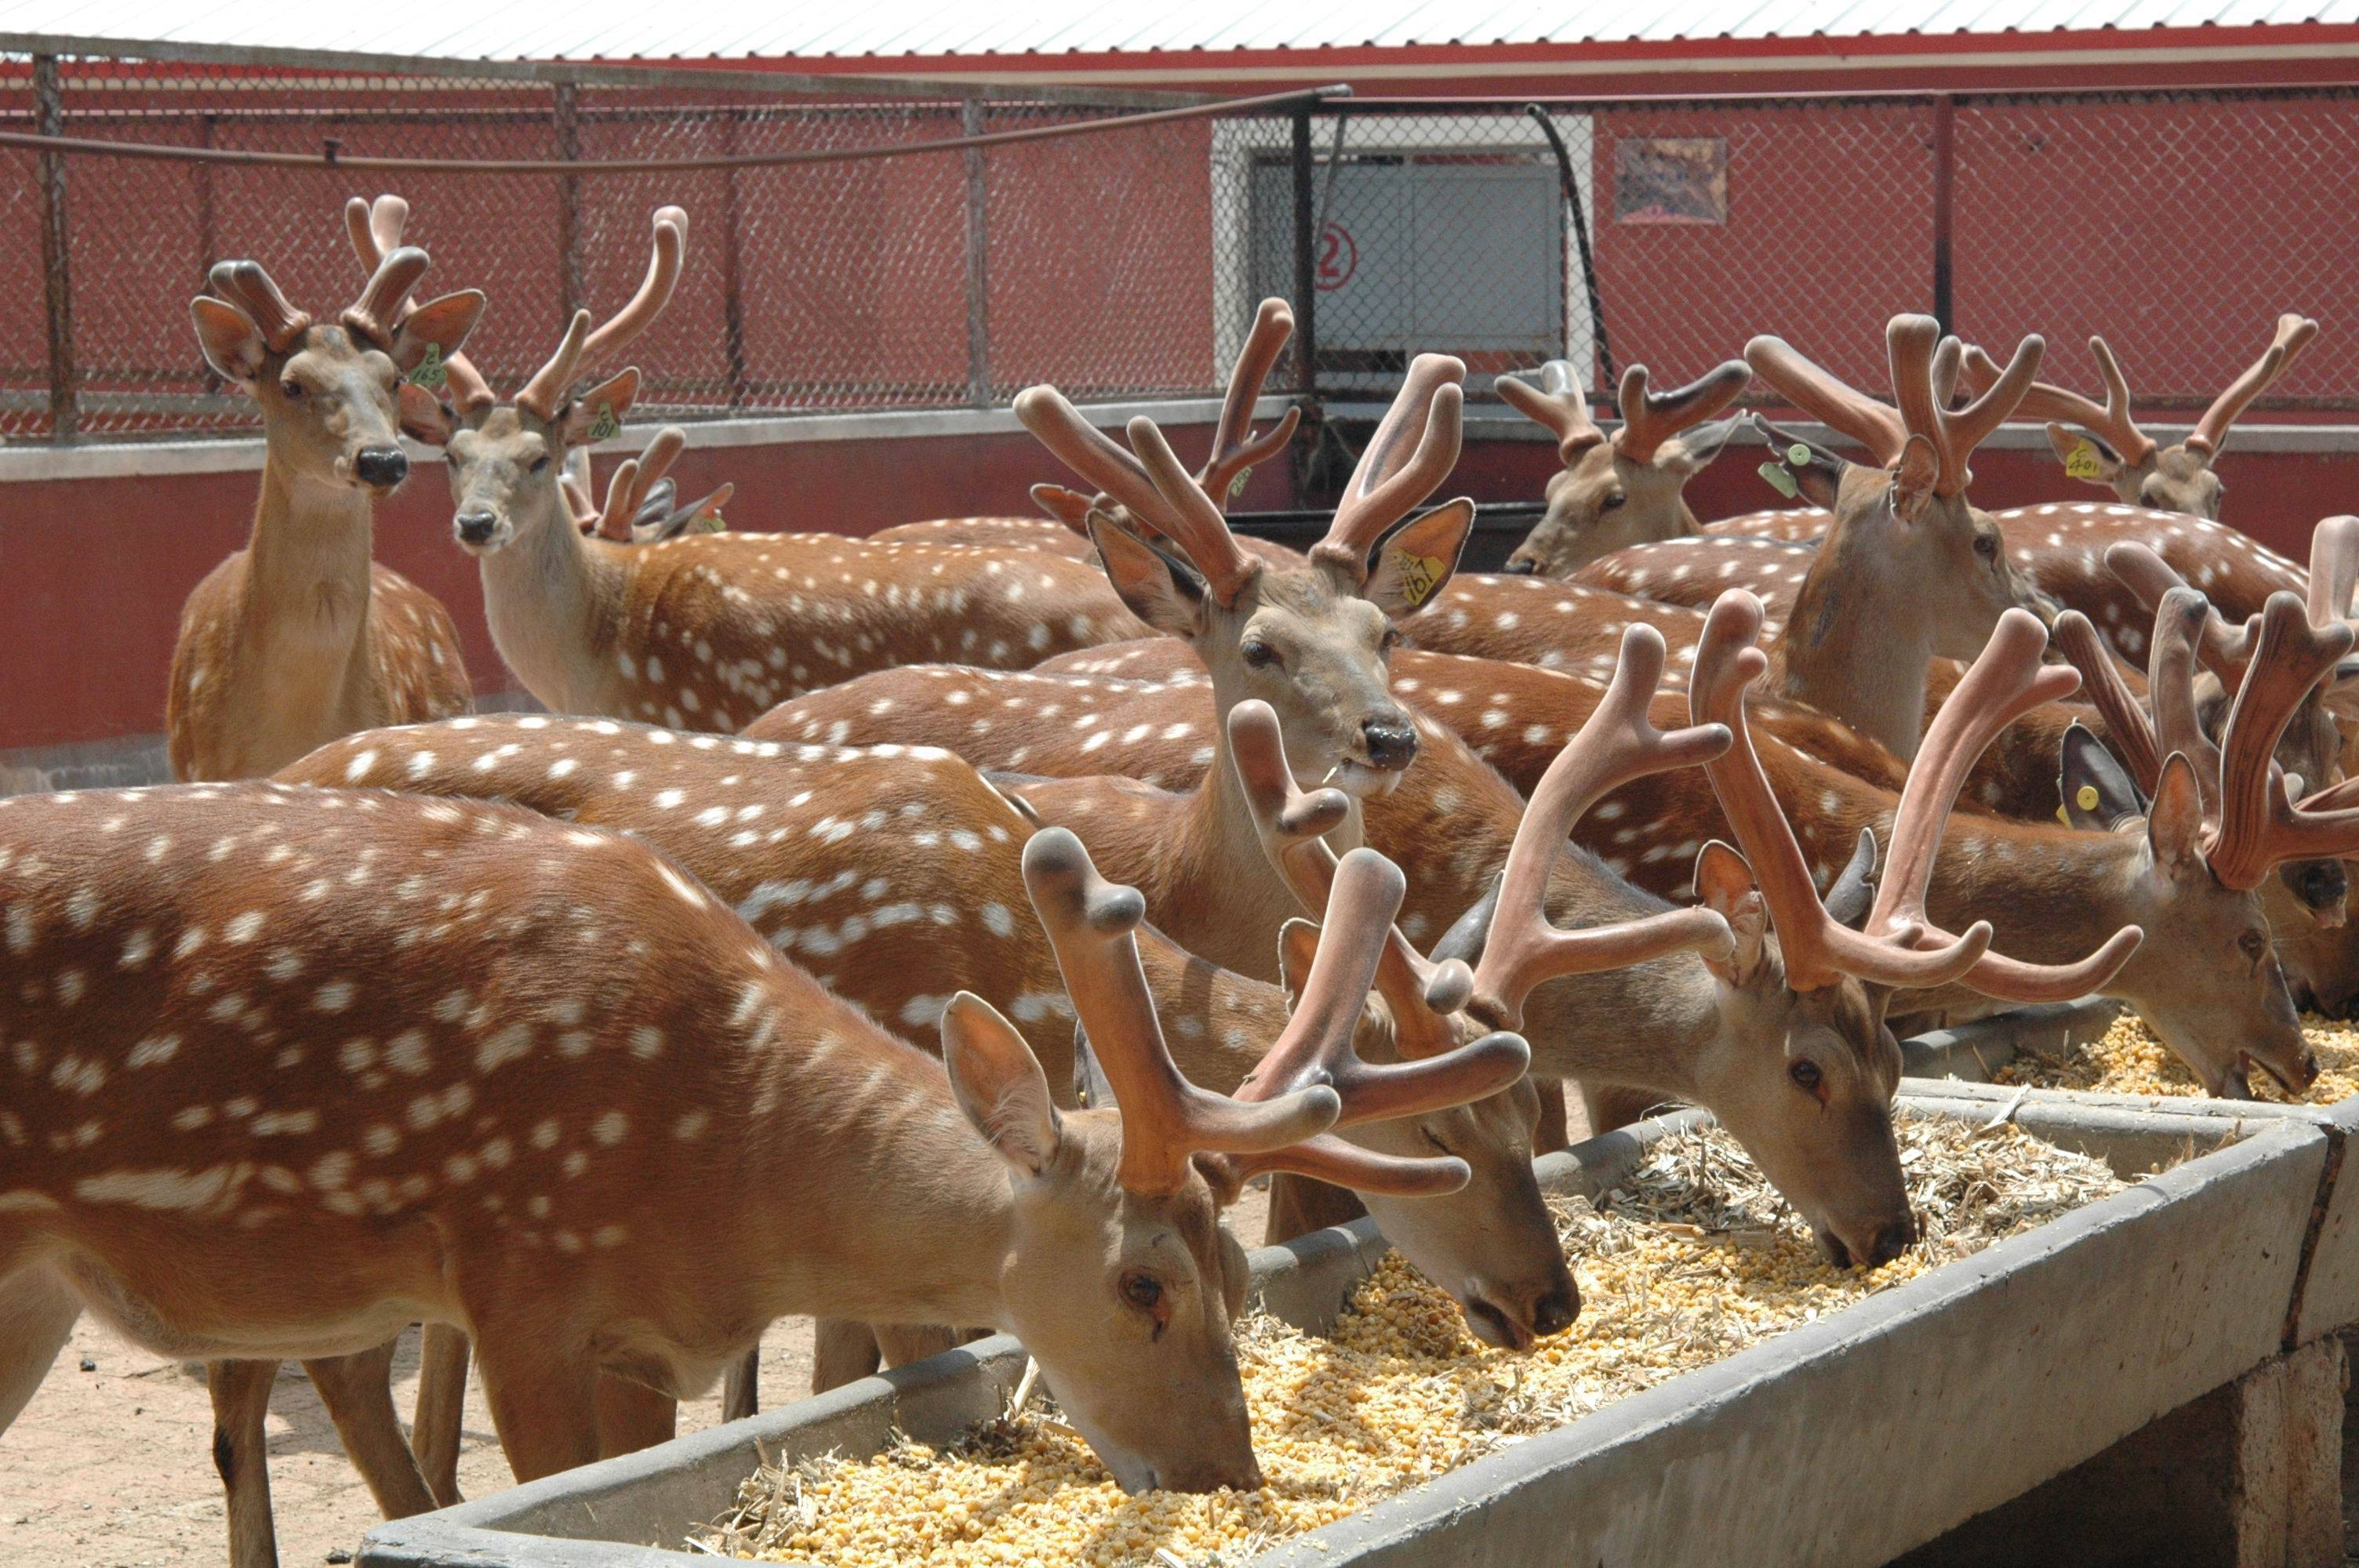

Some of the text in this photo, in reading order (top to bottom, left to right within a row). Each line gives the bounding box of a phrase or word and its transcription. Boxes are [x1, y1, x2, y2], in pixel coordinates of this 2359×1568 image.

[1318, 233, 1341, 277] 2
[413, 368, 440, 381] 165
[591, 422, 615, 437] 101
